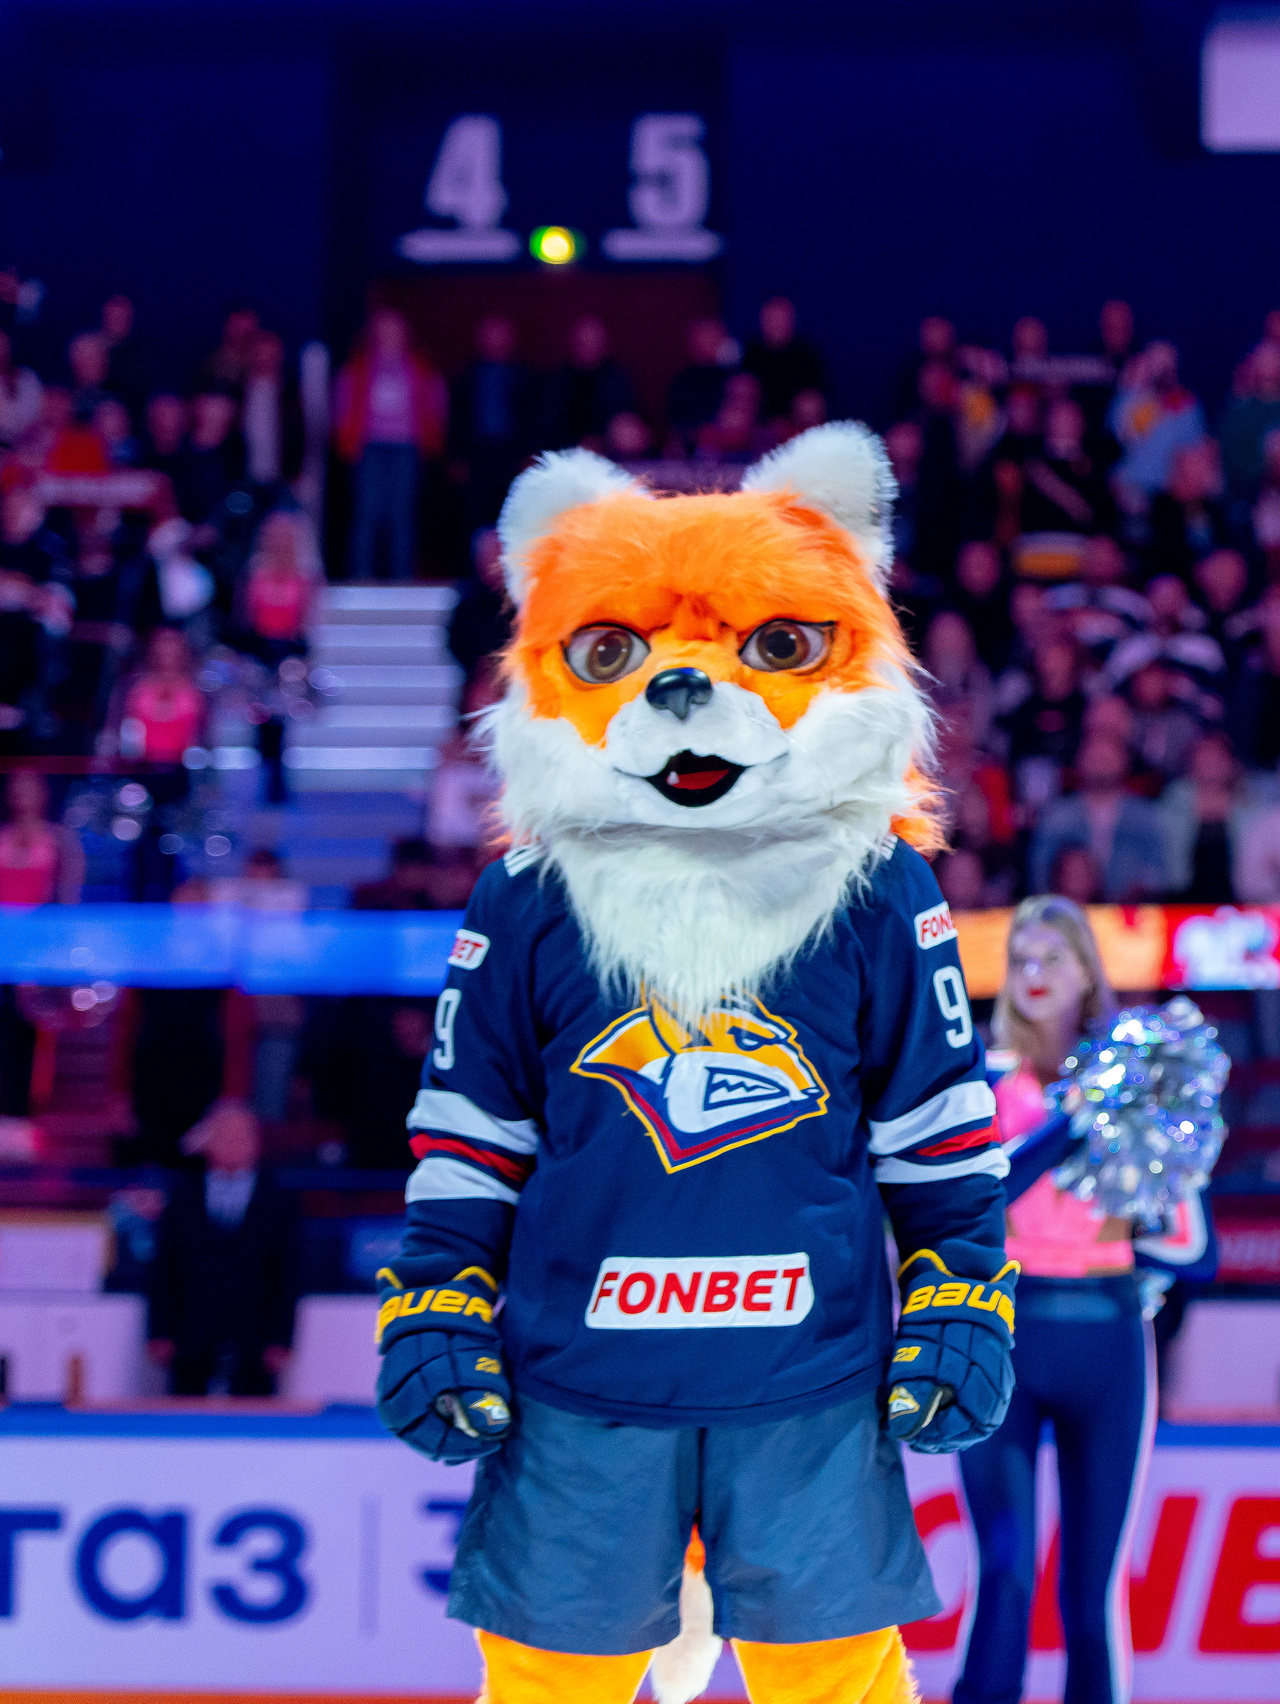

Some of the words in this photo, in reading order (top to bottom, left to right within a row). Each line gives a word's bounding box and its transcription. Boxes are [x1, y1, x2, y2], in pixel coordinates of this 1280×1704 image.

[425, 112, 508, 228] 4
[630, 111, 710, 228] 5
[921, 906, 956, 943] FON
[433, 988, 463, 1071] 9
[933, 966, 973, 1048] 9
[591, 1266, 805, 1315] FONBET
